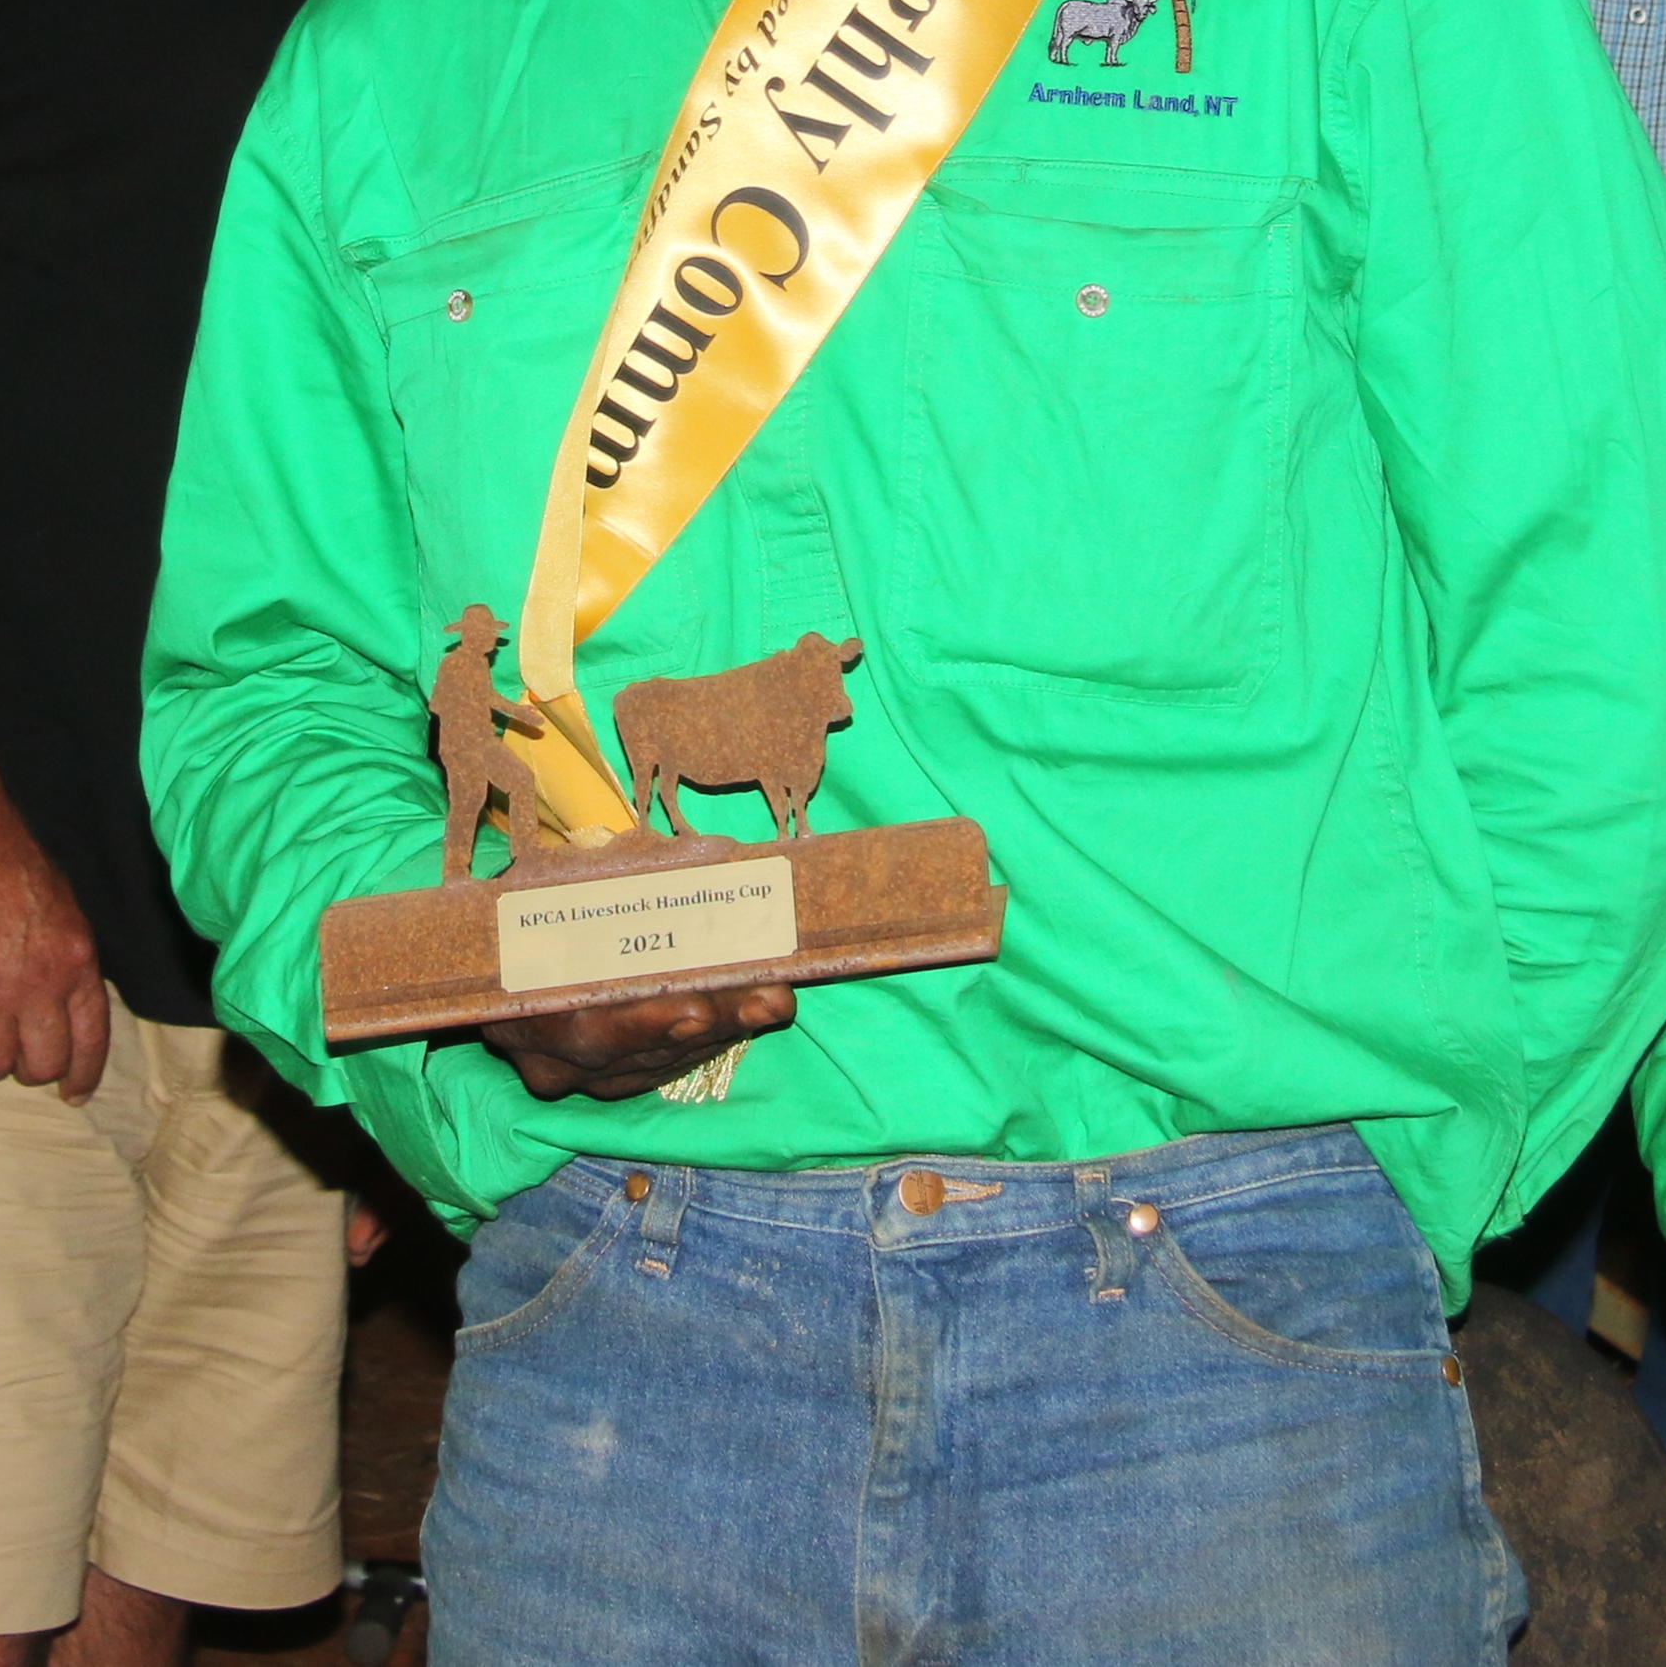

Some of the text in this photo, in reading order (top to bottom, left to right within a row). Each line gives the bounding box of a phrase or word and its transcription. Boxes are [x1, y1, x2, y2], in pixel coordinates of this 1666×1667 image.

[721, 46, 762, 98] by
[1028, 82, 1239, 118] Arnhem Land, NT
[583, 185, 811, 491] Comm
[519, 882, 773, 928] KPCA Livestock Handling Cup
[619, 931, 677, 956] 2021
